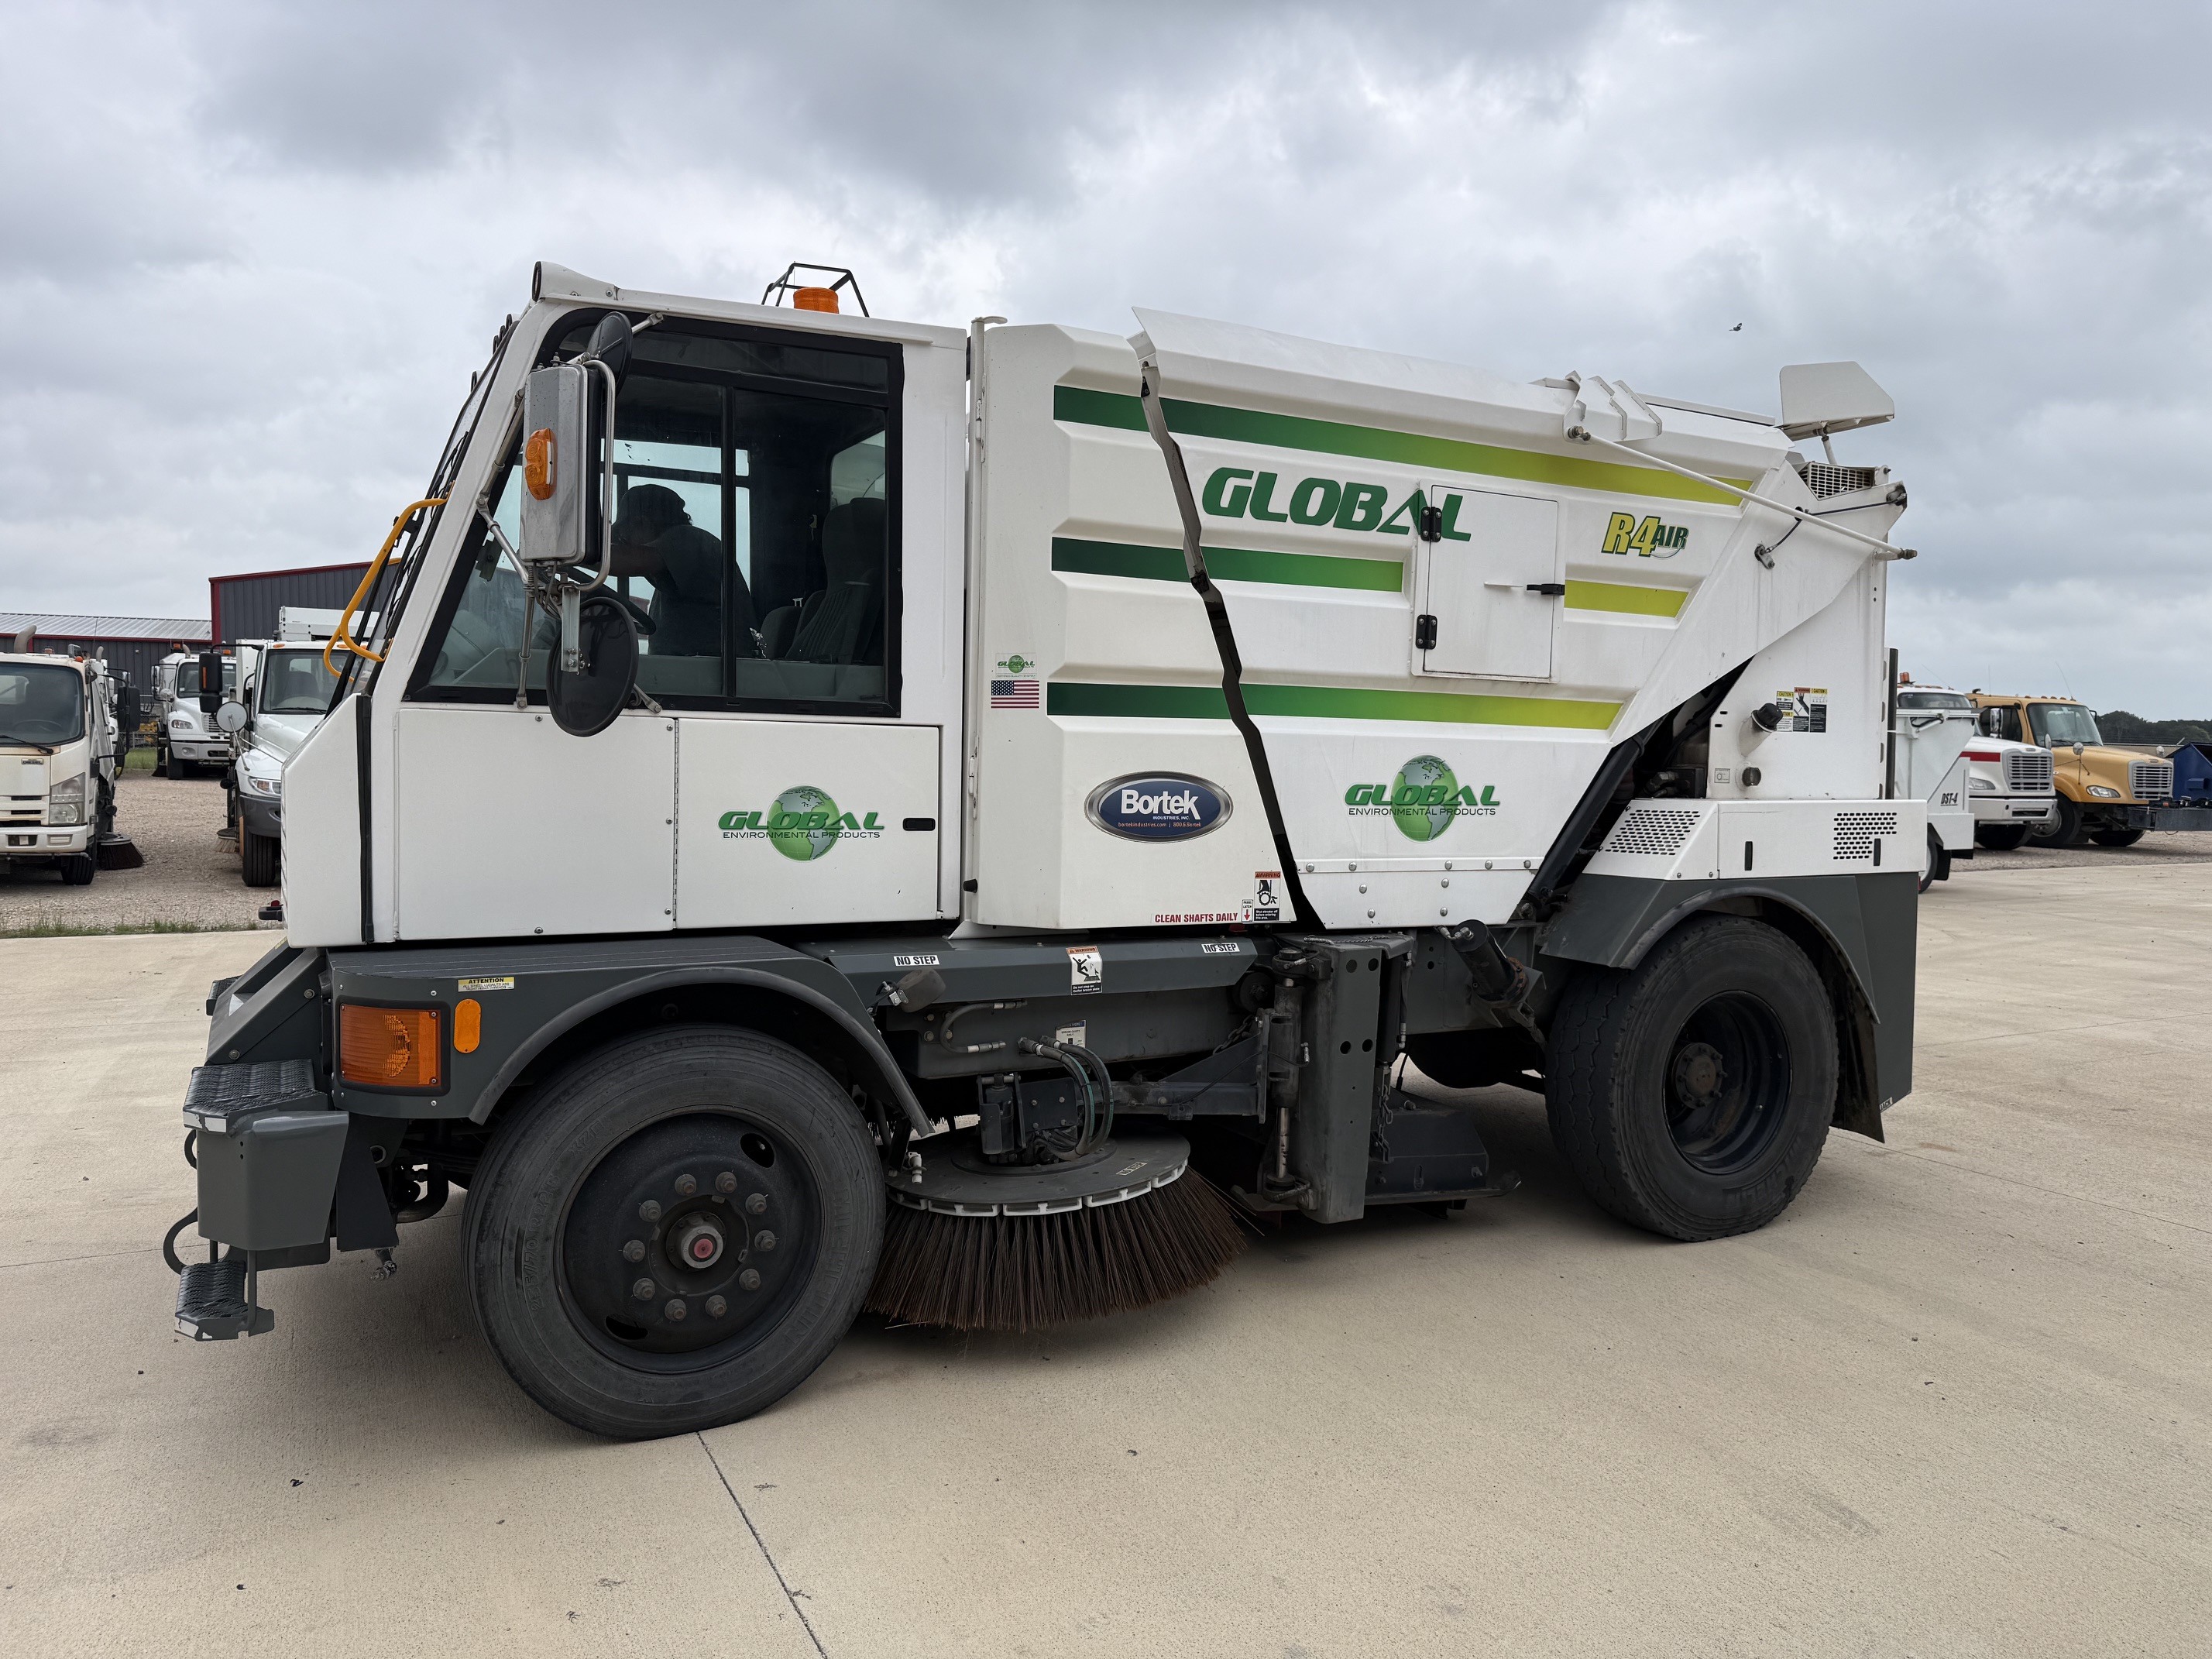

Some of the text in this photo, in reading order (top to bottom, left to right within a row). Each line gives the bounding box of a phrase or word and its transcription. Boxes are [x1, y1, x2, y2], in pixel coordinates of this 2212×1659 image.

[1202, 467, 1472, 541] GLOBAL
[1601, 512, 1689, 557] R4 AIR
[1121, 789, 1201, 819] Bortek
[1345, 785, 1500, 805] GLOBAL
[1941, 792, 1958, 804] DST-4
[718, 811, 884, 830] GLOBAL
[1155, 914, 1181, 922] CLEAN
[1216, 913, 1238, 922] DAILY
[896, 956, 936, 965] NO STEP
